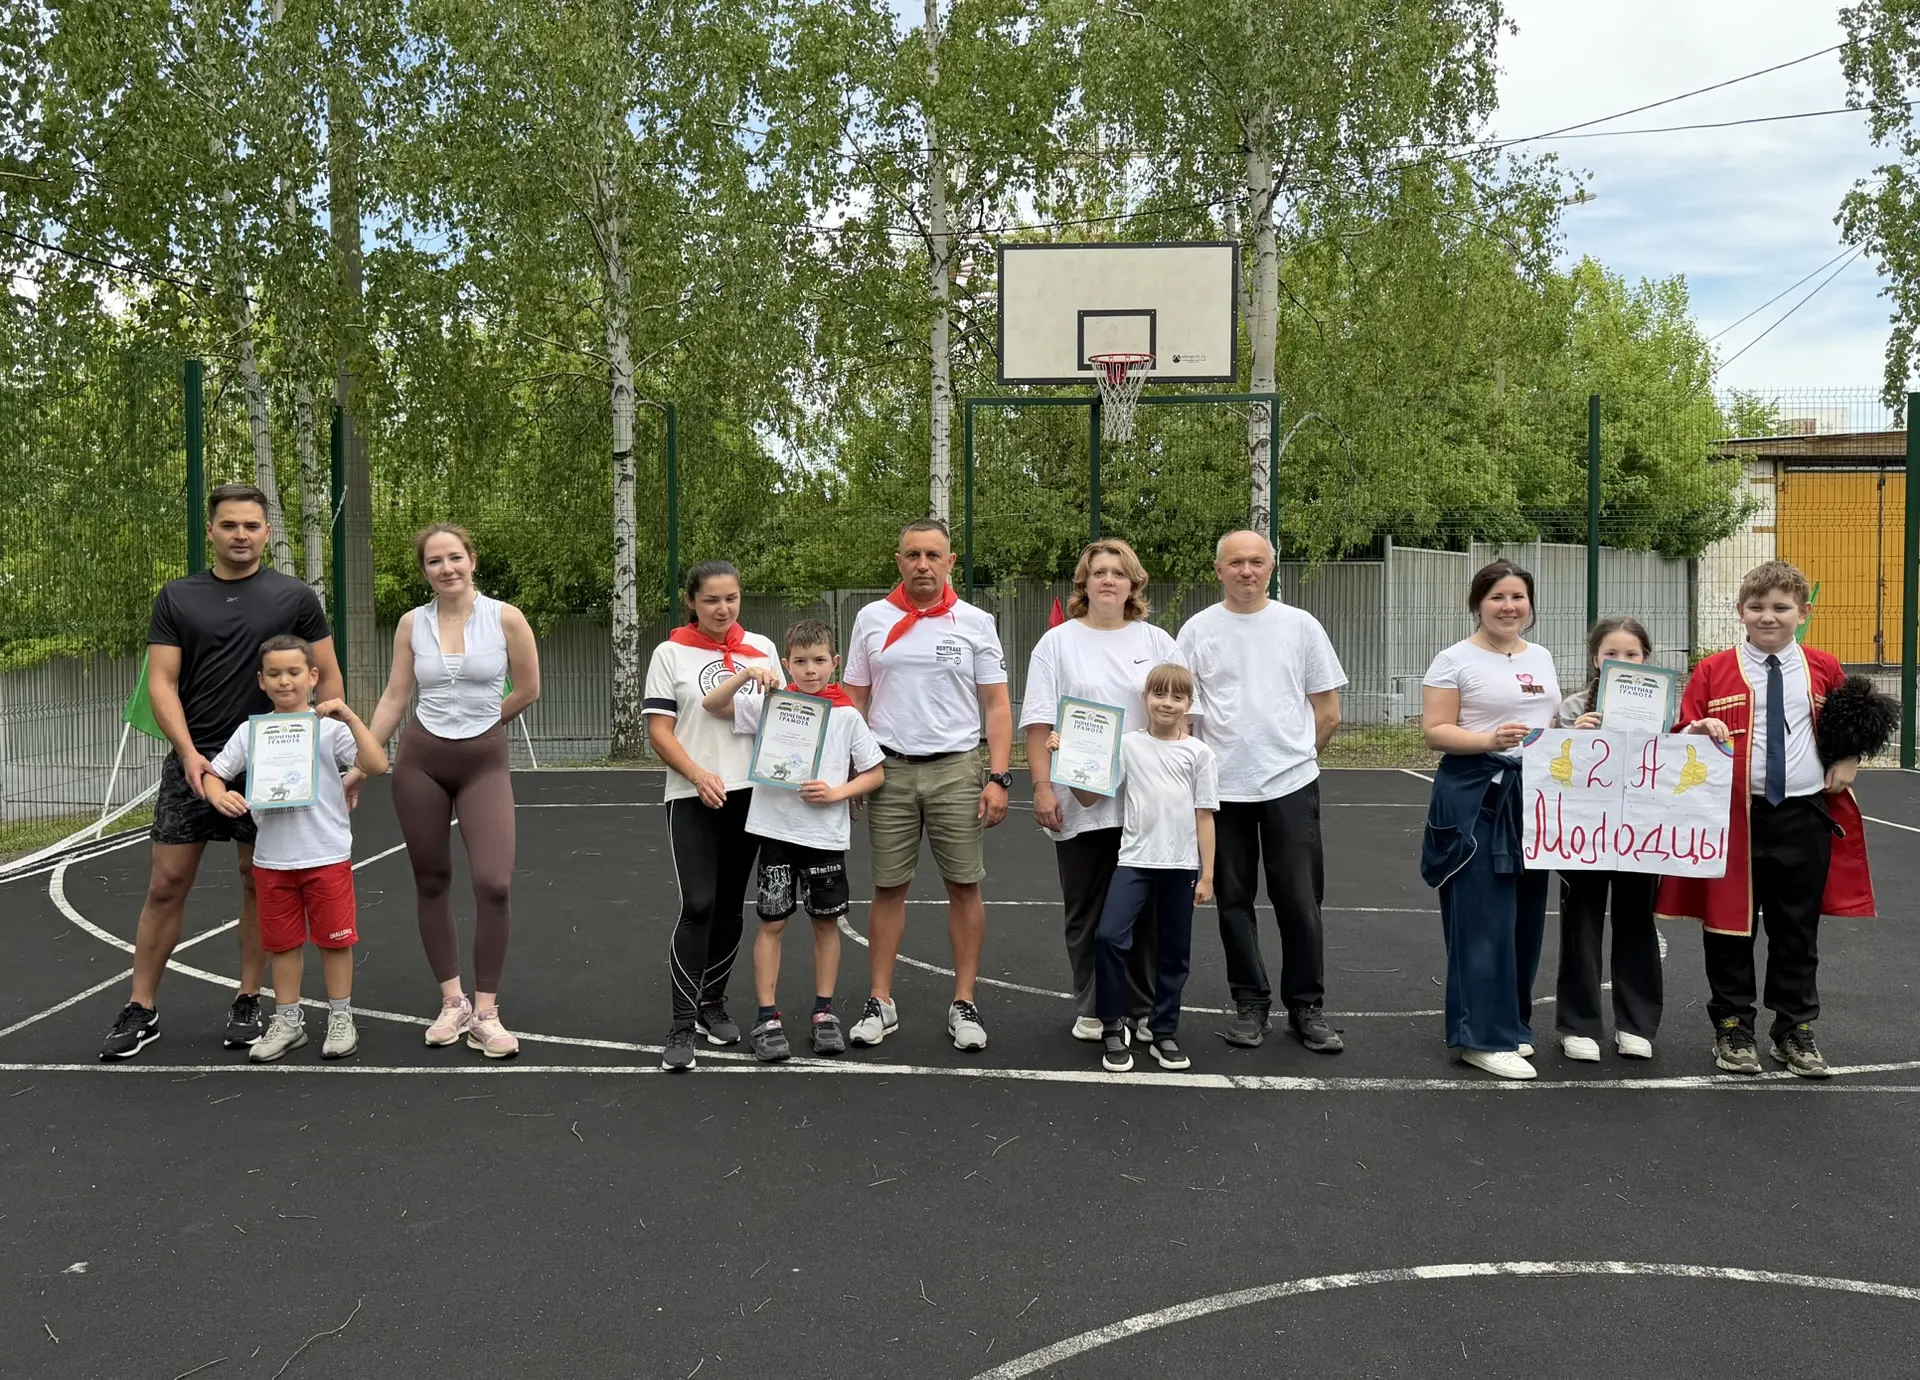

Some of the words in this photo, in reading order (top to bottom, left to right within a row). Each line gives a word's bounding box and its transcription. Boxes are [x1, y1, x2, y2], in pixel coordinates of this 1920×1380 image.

[1619, 689, 1652, 698] ГРАМОТА
[779, 717, 809, 726] ГРАМОТА
[1074, 725, 1103, 734] ГРАМОТА
[1587, 738, 1613, 788] 2
[1631, 736, 1666, 789] А
[1525, 789, 1724, 865] Молодцы
